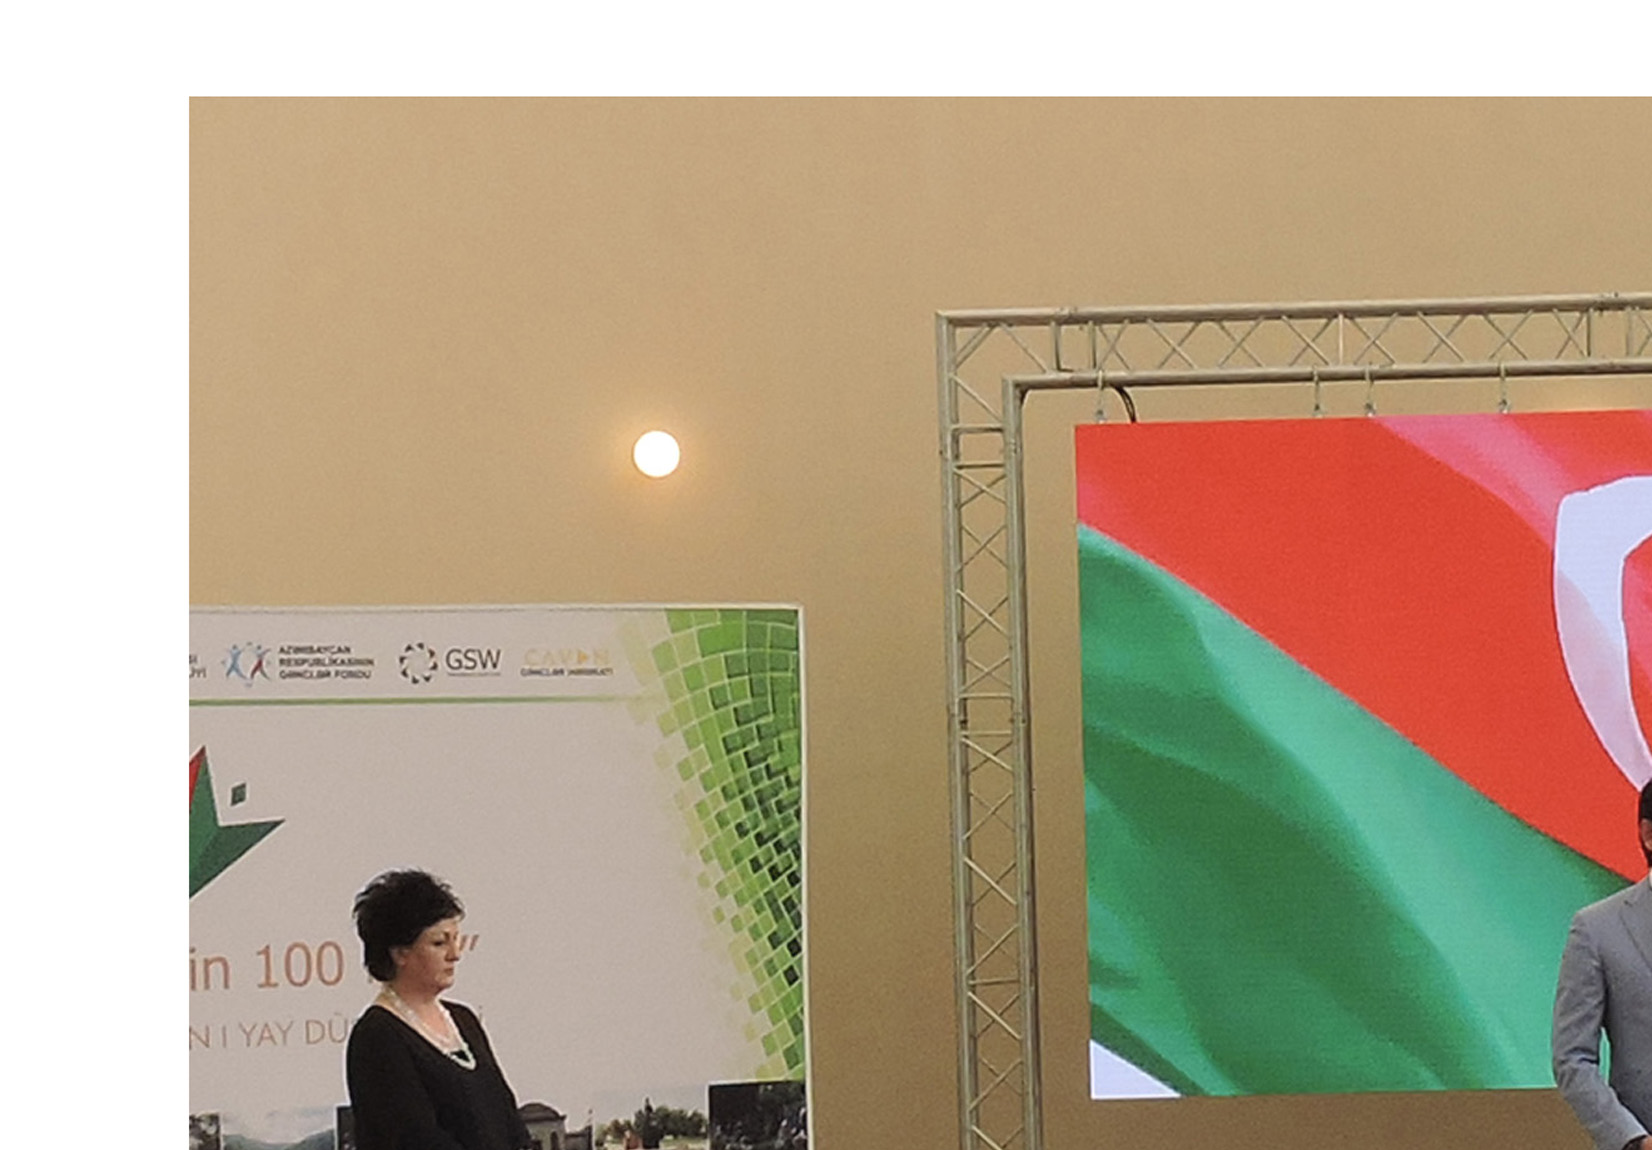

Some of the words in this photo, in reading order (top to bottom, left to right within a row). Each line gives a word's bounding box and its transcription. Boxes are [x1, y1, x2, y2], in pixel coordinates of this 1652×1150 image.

[446, 649, 501, 671] GSW
[255, 941, 345, 988] 100
[239, 1021, 294, 1046] YAY
